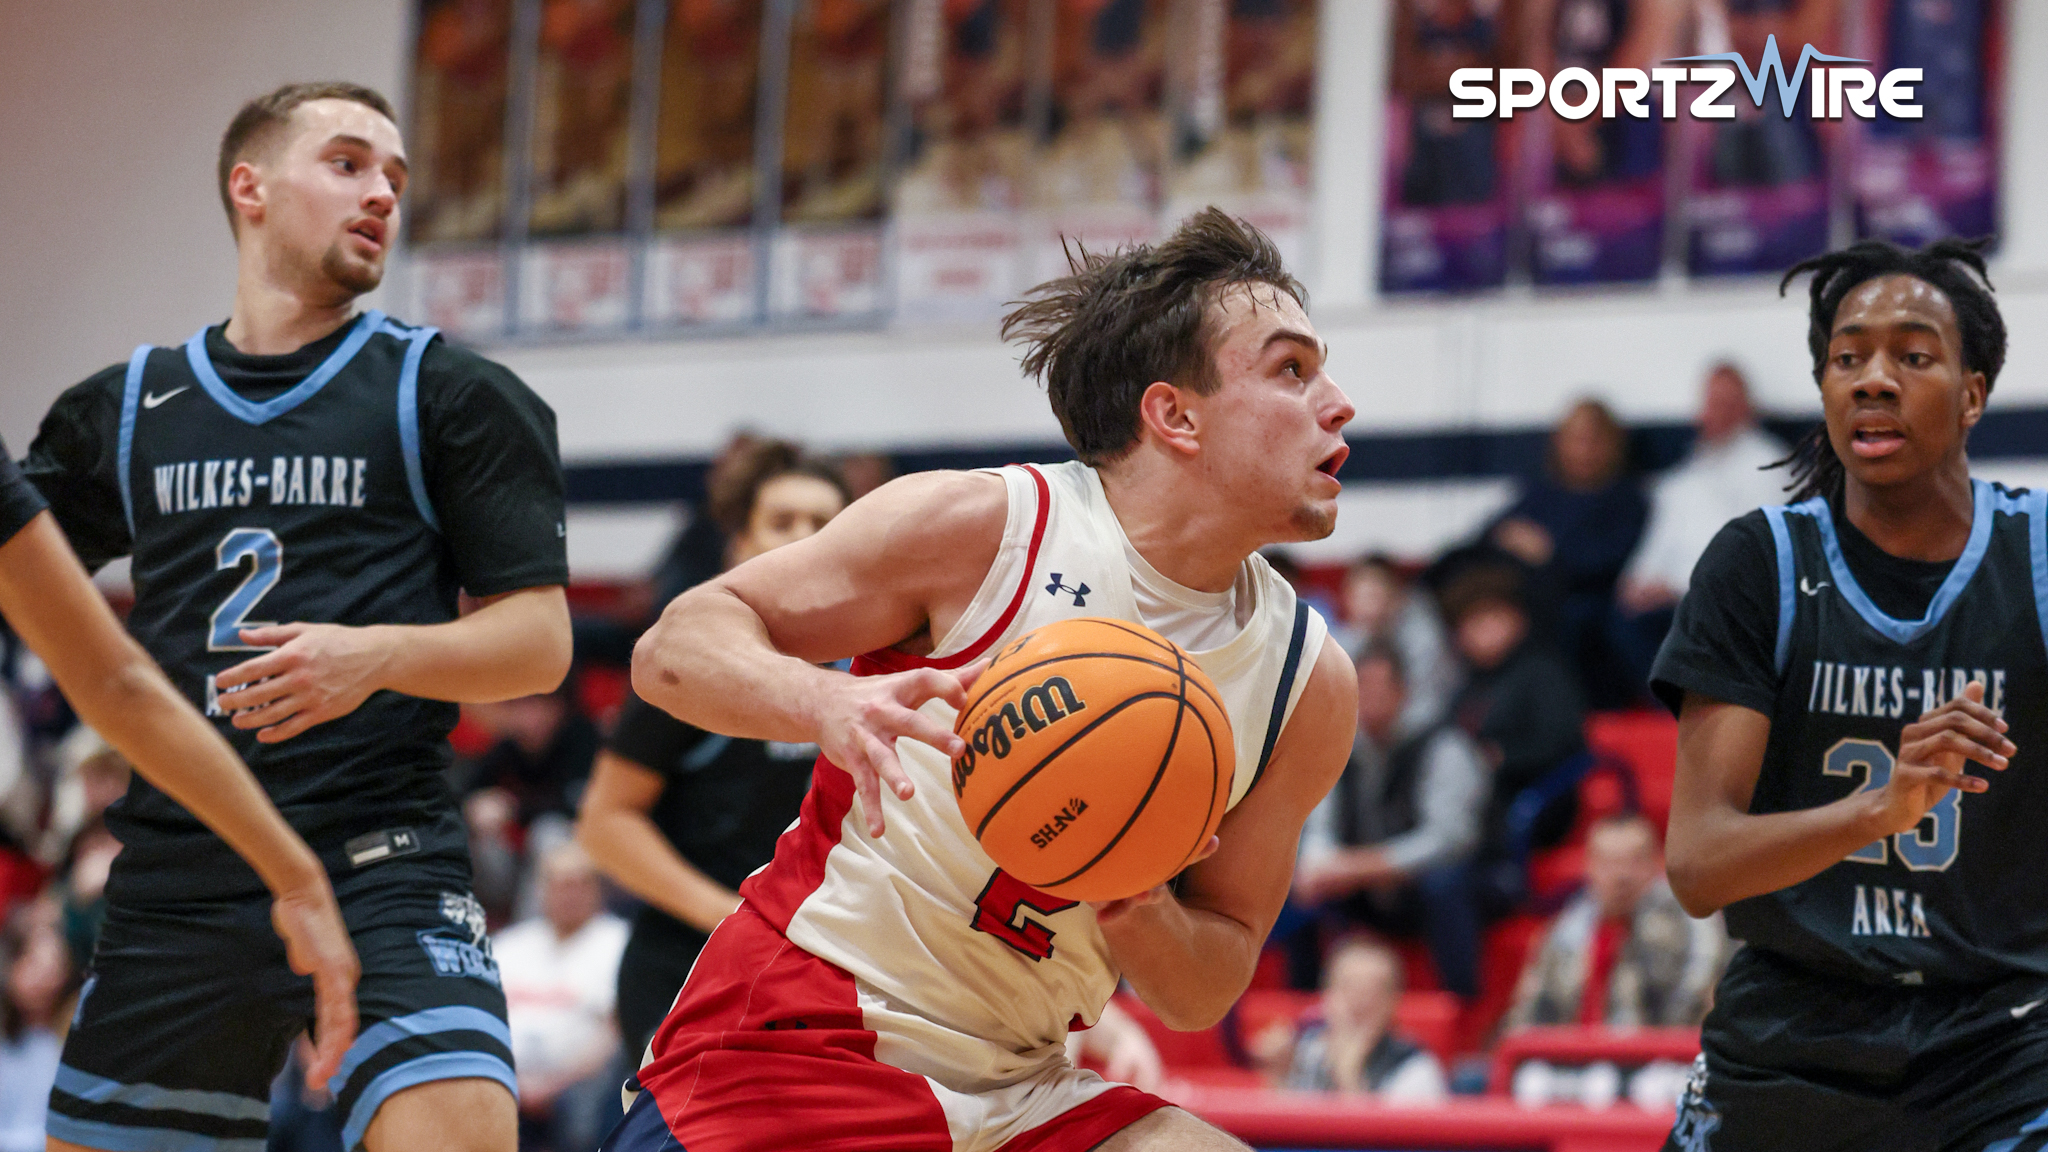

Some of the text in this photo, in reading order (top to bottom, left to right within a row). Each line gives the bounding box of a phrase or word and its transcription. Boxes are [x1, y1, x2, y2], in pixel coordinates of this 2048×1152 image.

[154, 456, 367, 514] WILKES-BARRE
[208, 528, 283, 652] 2
[951, 675, 1087, 798] Wilson
[1030, 806, 1077, 850] NFHS
[1851, 884, 1932, 938] AREA
